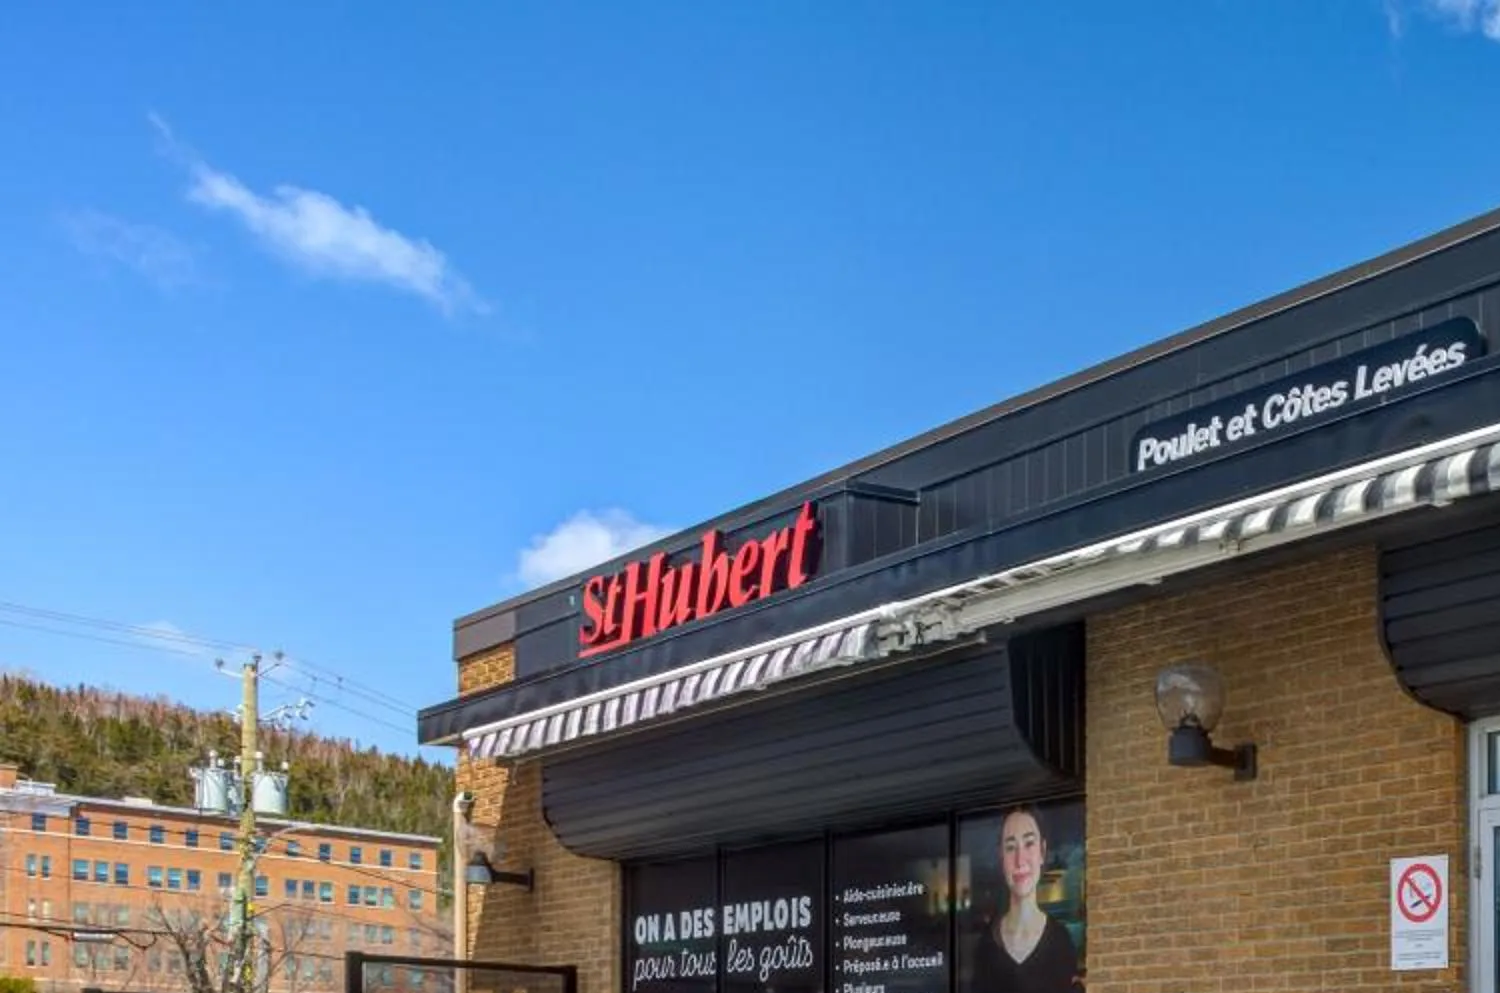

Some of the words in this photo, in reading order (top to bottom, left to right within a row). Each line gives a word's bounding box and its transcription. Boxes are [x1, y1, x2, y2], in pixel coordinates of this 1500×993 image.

[1137, 415, 1222, 472] Poulet
[1226, 404, 1257, 441] et
[1262, 380, 1349, 430] Côtes
[1354, 340, 1467, 400] Levées
[634, 913, 660, 945] ON
[663, 913, 676, 942] A
[680, 907, 716, 940] DES
[723, 896, 812, 935] EMPLOIS
[632, 953, 676, 991] pour
[726, 939, 756, 973] les
[759, 934, 814, 982] goûts
